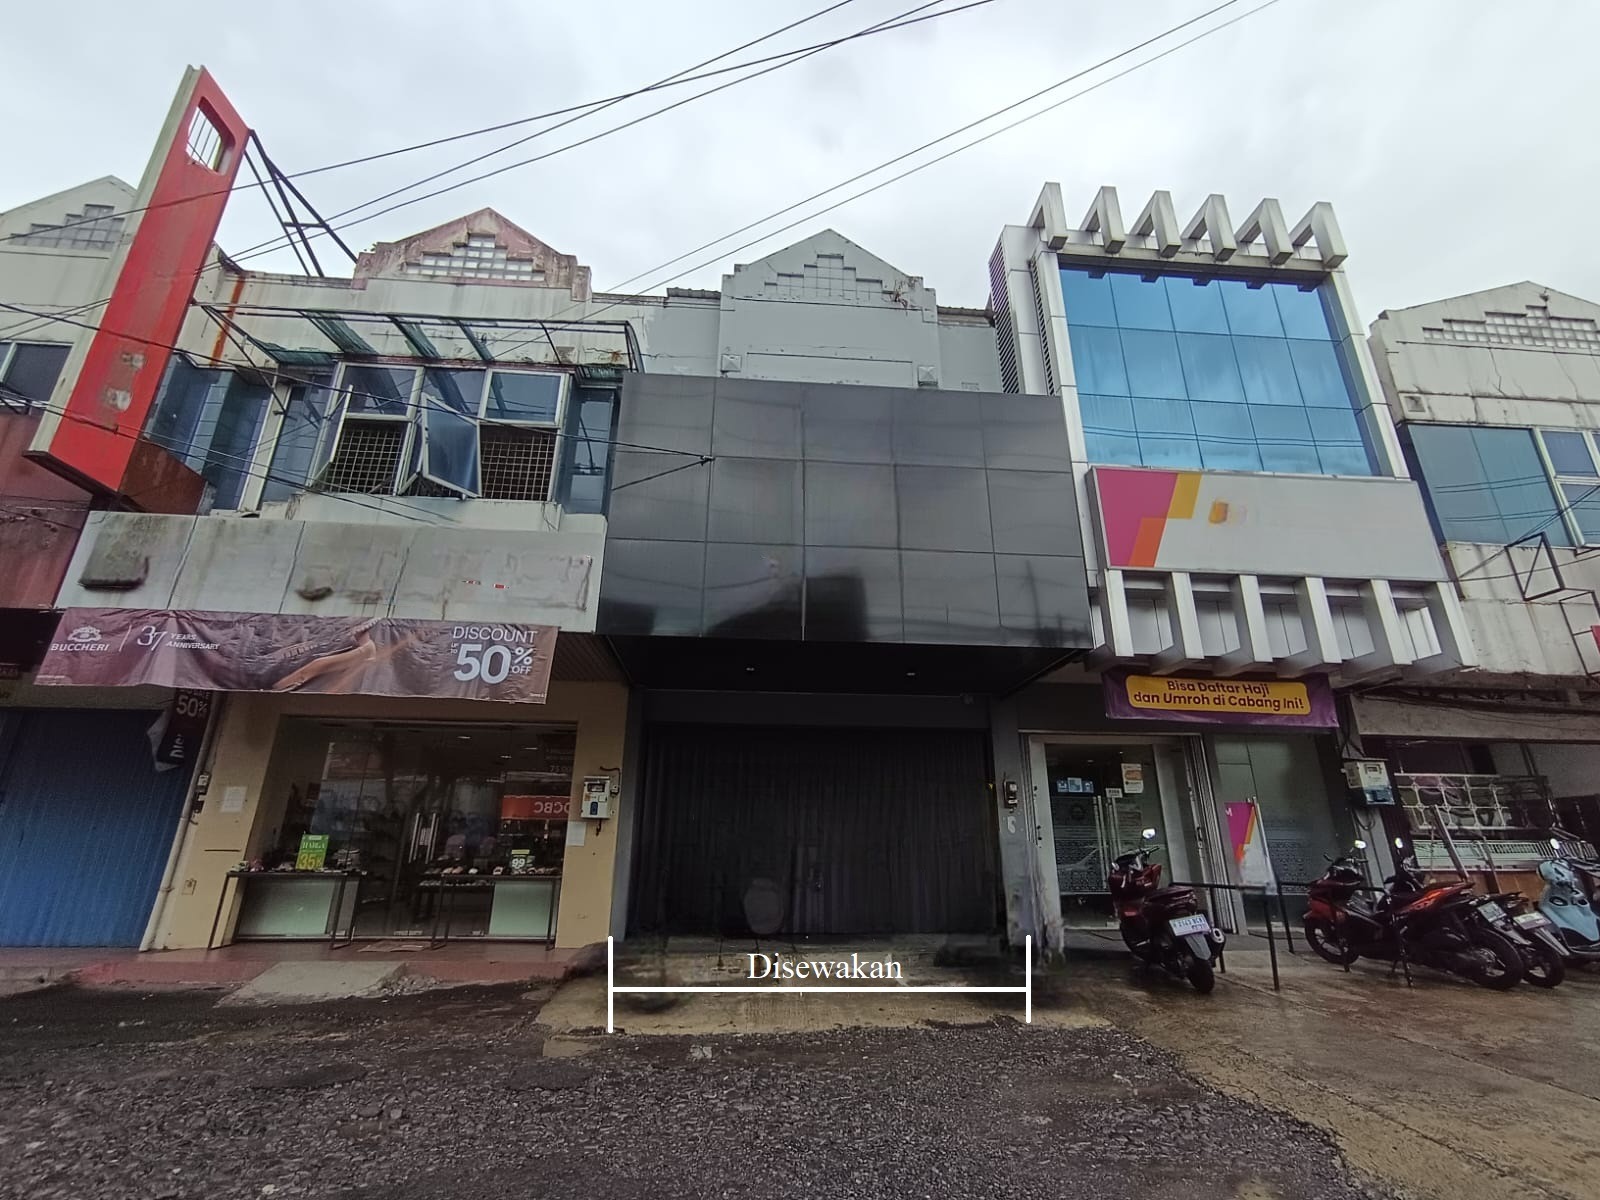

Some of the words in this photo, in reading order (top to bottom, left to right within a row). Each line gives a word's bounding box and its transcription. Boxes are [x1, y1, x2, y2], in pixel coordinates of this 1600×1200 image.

[137, 625, 167, 651] 37
[453, 626, 538, 643] DISCOUNT
[51, 643, 110, 651] BUCCHERI
[166, 640, 221, 650] ANNIVERSARY
[454, 644, 534, 684] 50%
[512, 665, 533, 674] OFF
[1167, 680, 1195, 692] Bisa
[1198, 682, 1240, 694] Daftar
[1243, 683, 1270, 697] Haji
[1133, 691, 1160, 704] dan
[1163, 693, 1210, 705] Umroh
[1213, 694, 1225, 706] di
[1228, 695, 1281, 711] Cabang
[1283, 698, 1304, 709] Ini!
